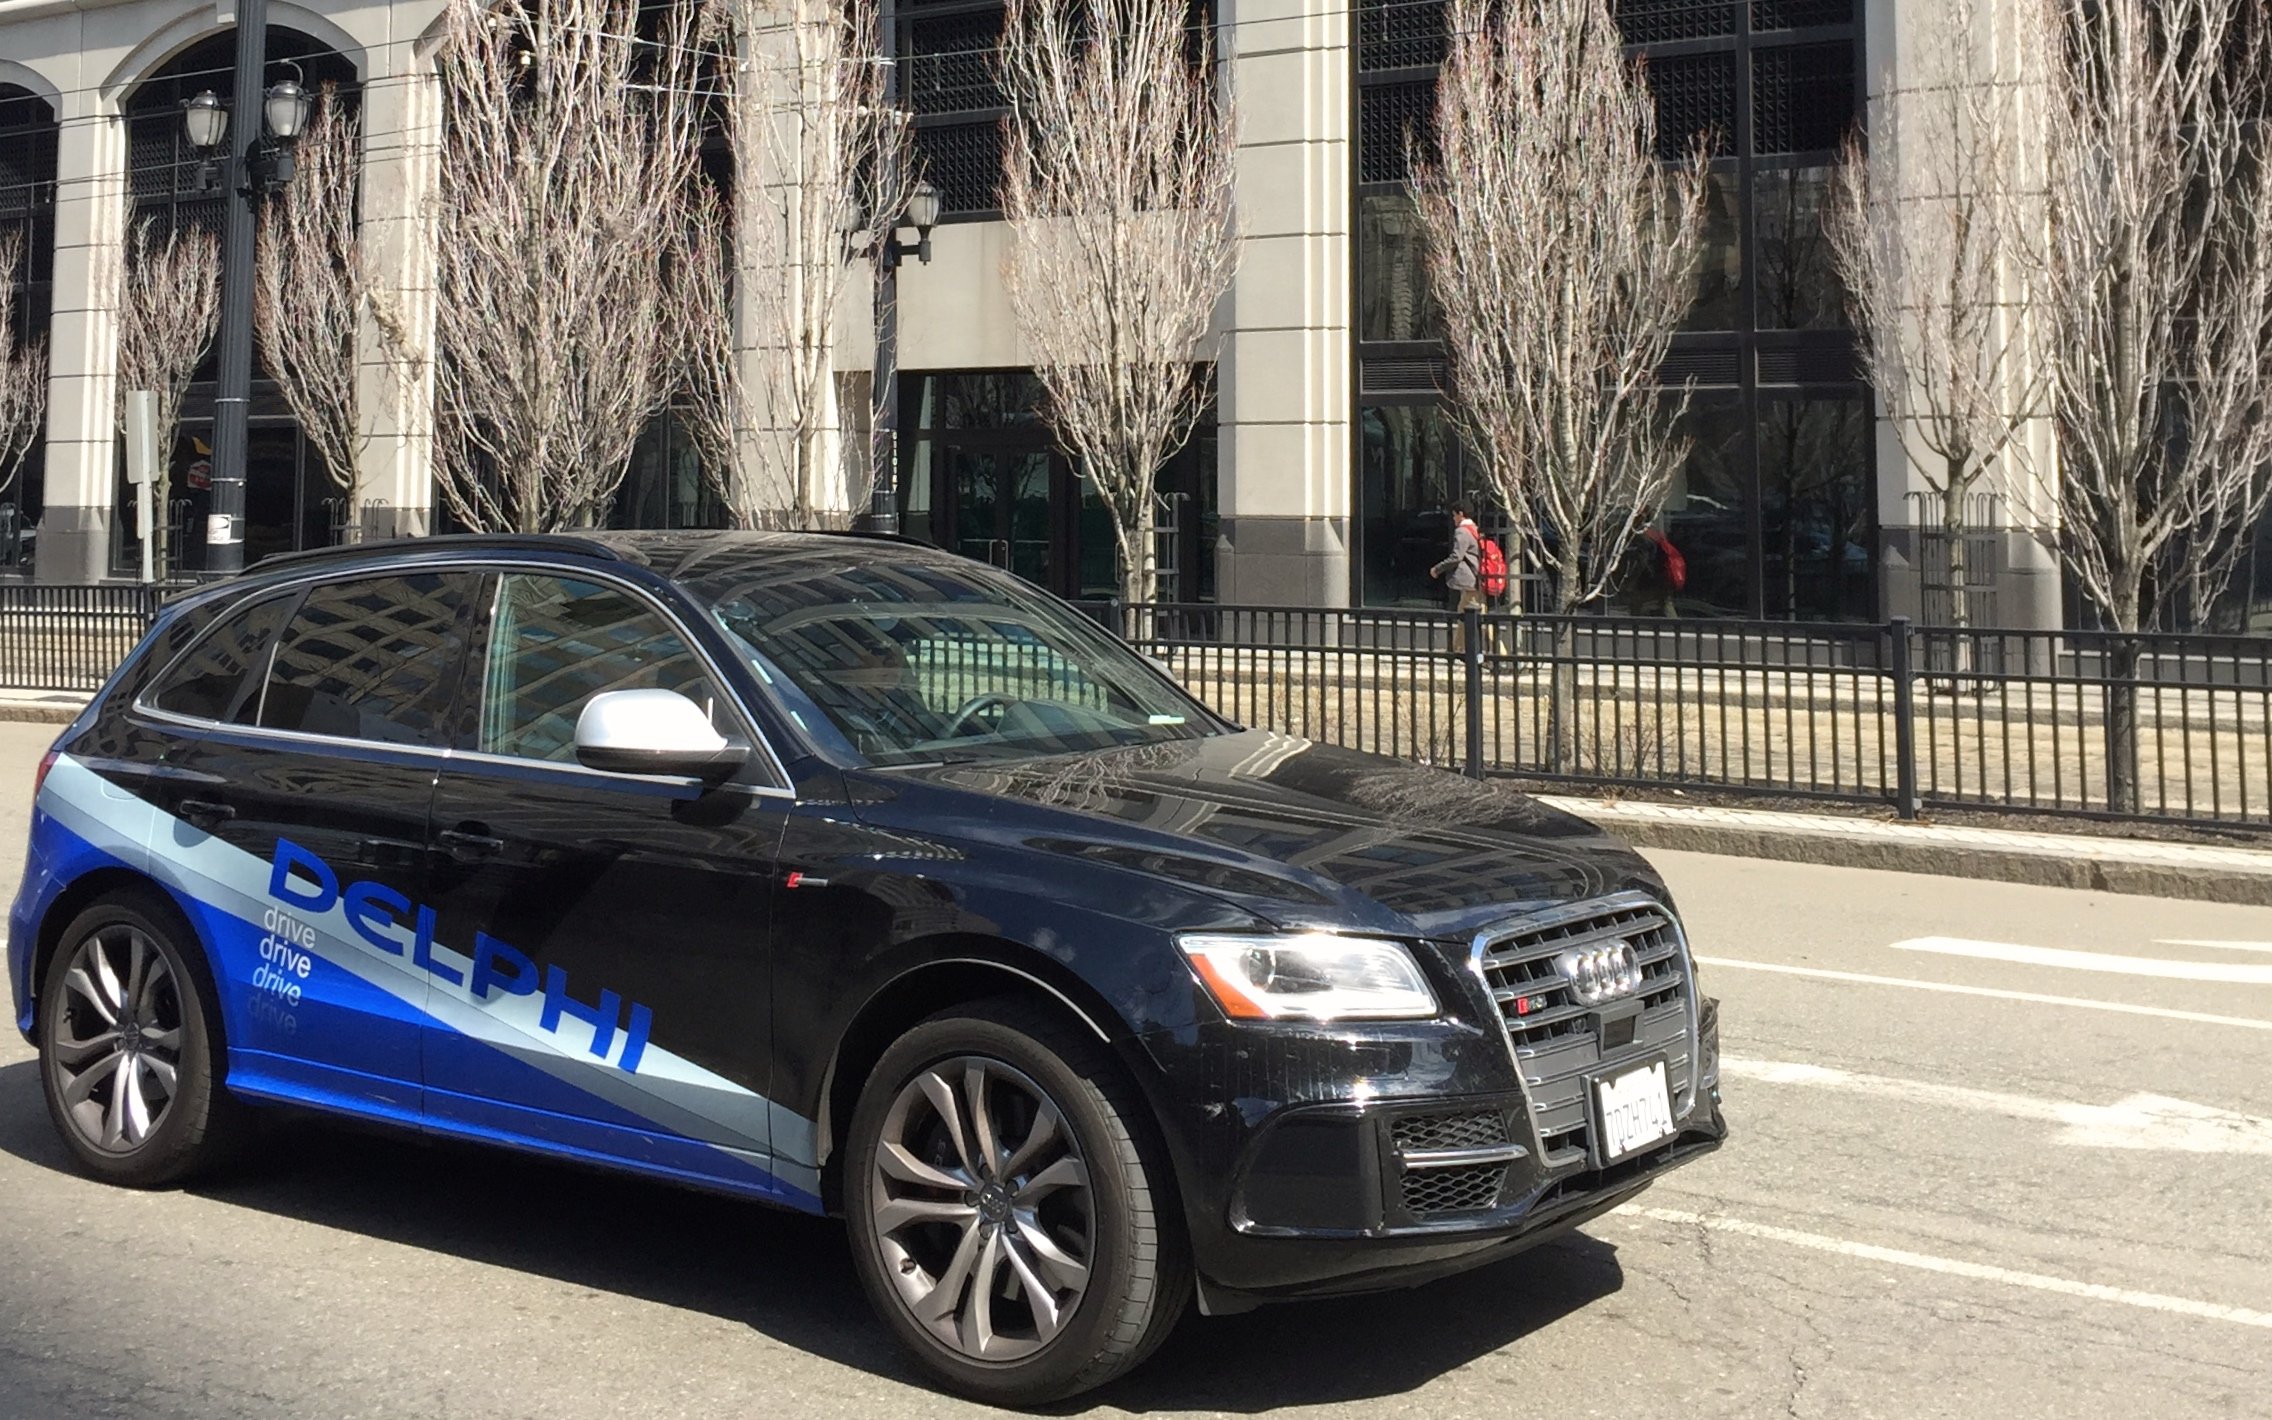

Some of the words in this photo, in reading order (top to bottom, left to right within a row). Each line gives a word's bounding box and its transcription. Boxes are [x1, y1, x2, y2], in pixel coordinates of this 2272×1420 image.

[263, 904, 316, 949] drive
[258, 933, 312, 979] drive
[268, 837, 653, 1075] DELPHI
[252, 962, 302, 1007] drive
